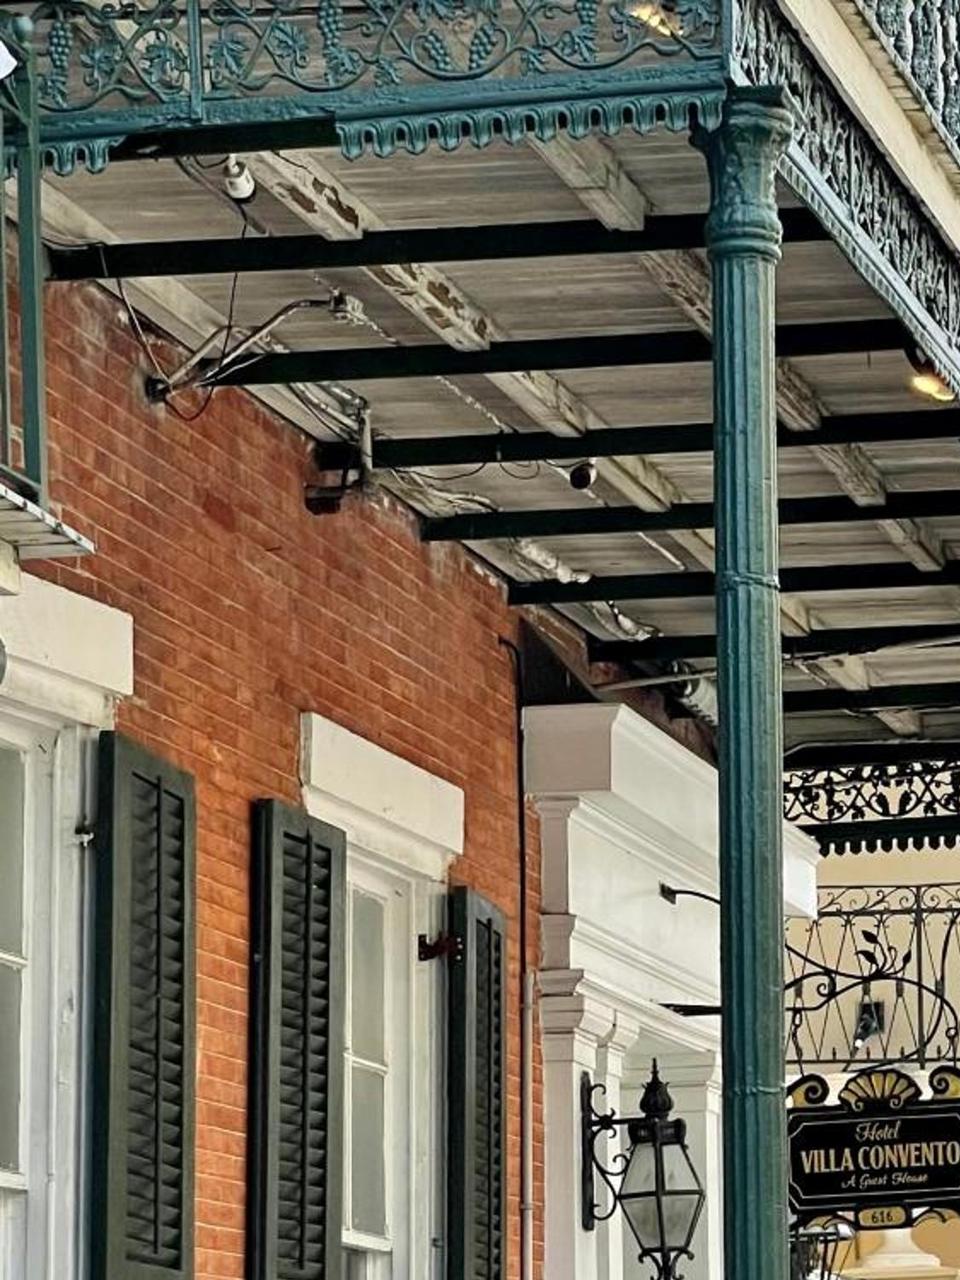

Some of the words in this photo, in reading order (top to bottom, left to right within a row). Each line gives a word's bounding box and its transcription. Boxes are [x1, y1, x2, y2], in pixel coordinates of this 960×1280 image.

[855, 1120, 901, 1142] Hotel
[800, 1148, 855, 1175] VILLA
[841, 1174, 857, 1189] A
[859, 1173, 888, 1190] Guest
[891, 1171, 929, 1186] House
[870, 1211, 894, 1225] 616
